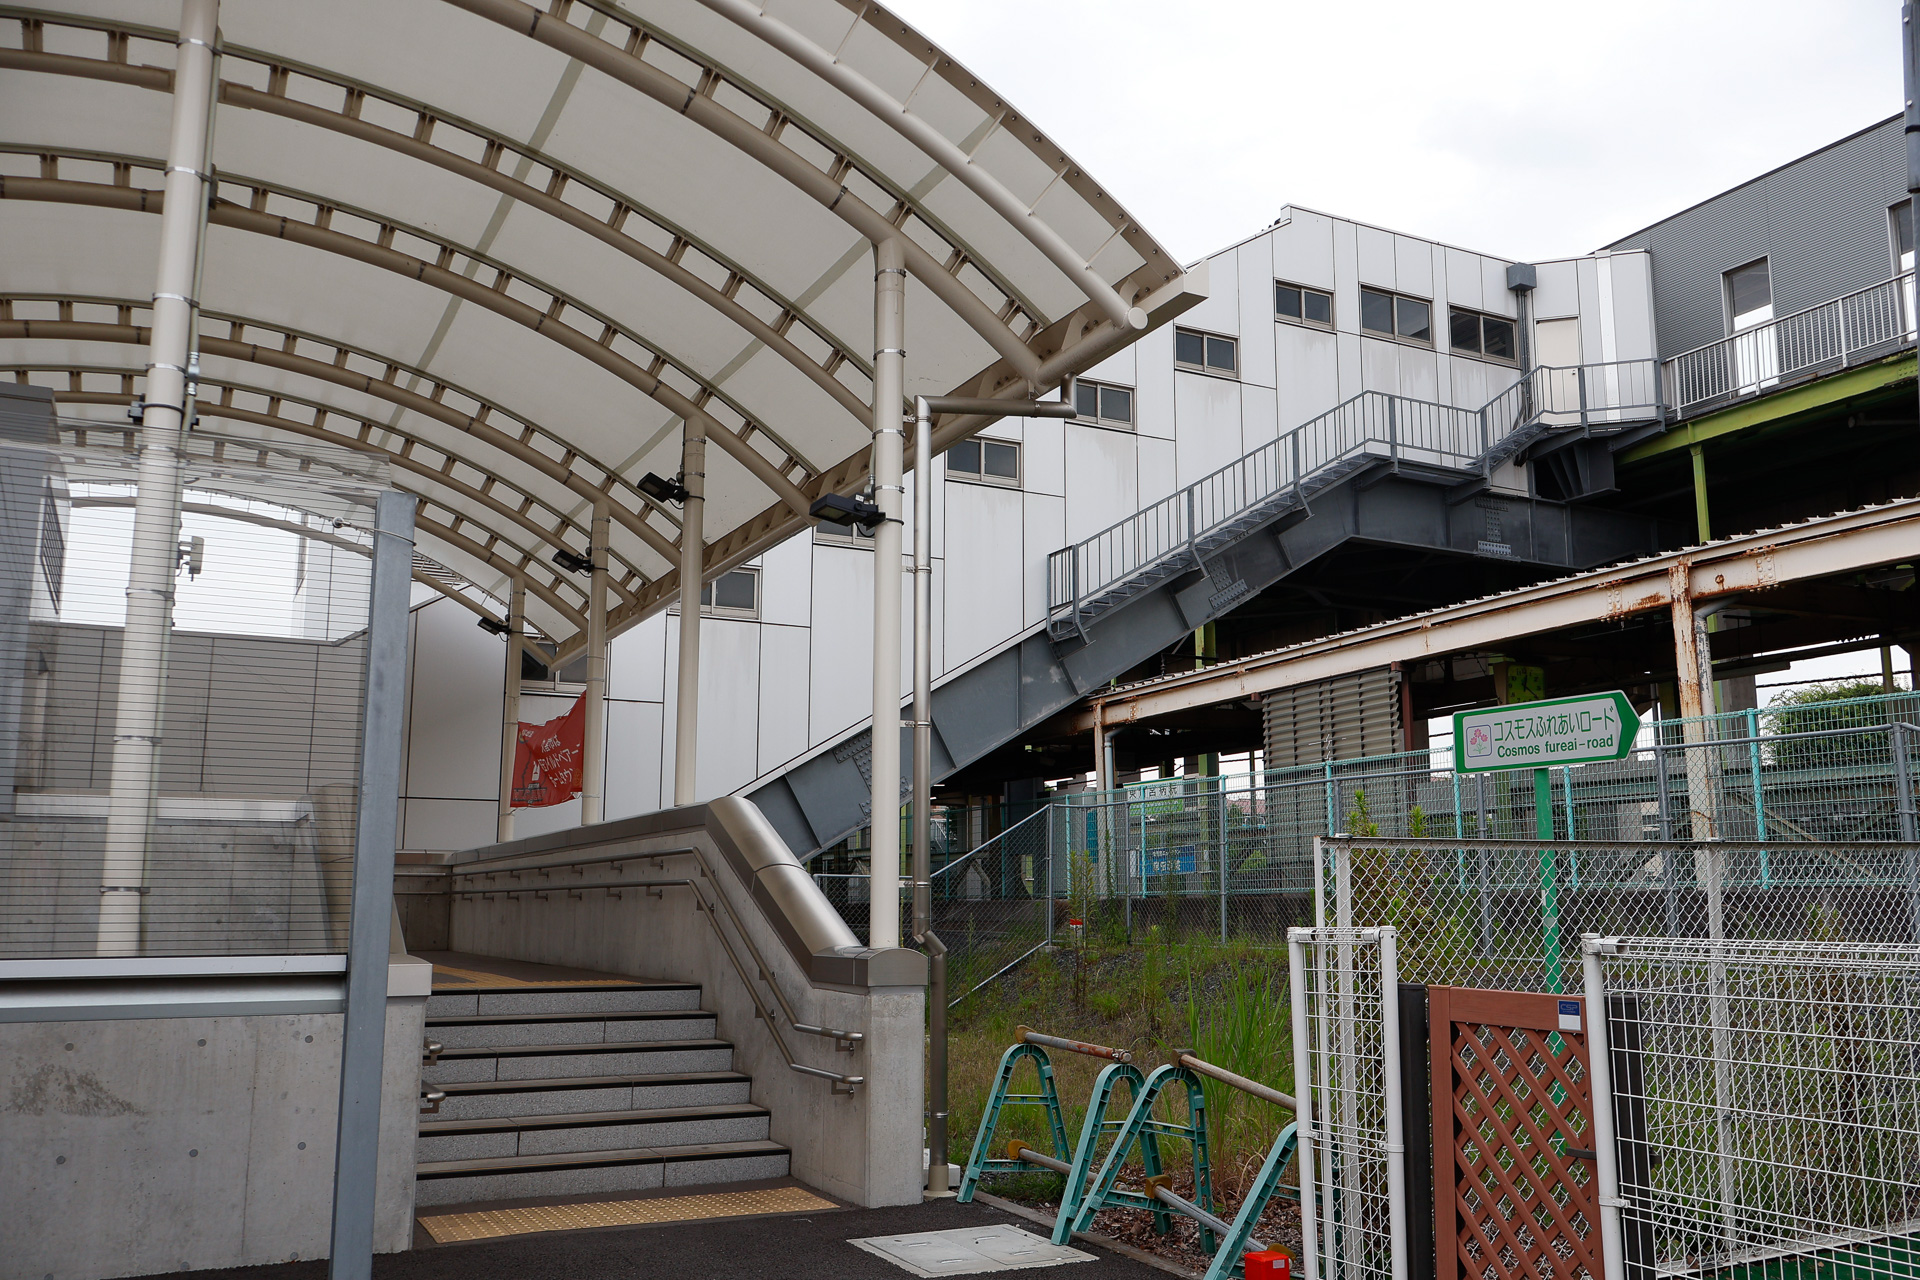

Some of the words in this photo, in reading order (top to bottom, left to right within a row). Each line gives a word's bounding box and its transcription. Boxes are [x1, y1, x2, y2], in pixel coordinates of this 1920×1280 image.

[1494, 706, 1615, 742] コスモスふれあいロード
[1497, 743, 1540, 758] Cosmos
[1545, 734, 1613, 753] fureai-road
[1128, 783, 1178, 799] 東宮病院
[1560, 1003, 1578, 1011] CSP
